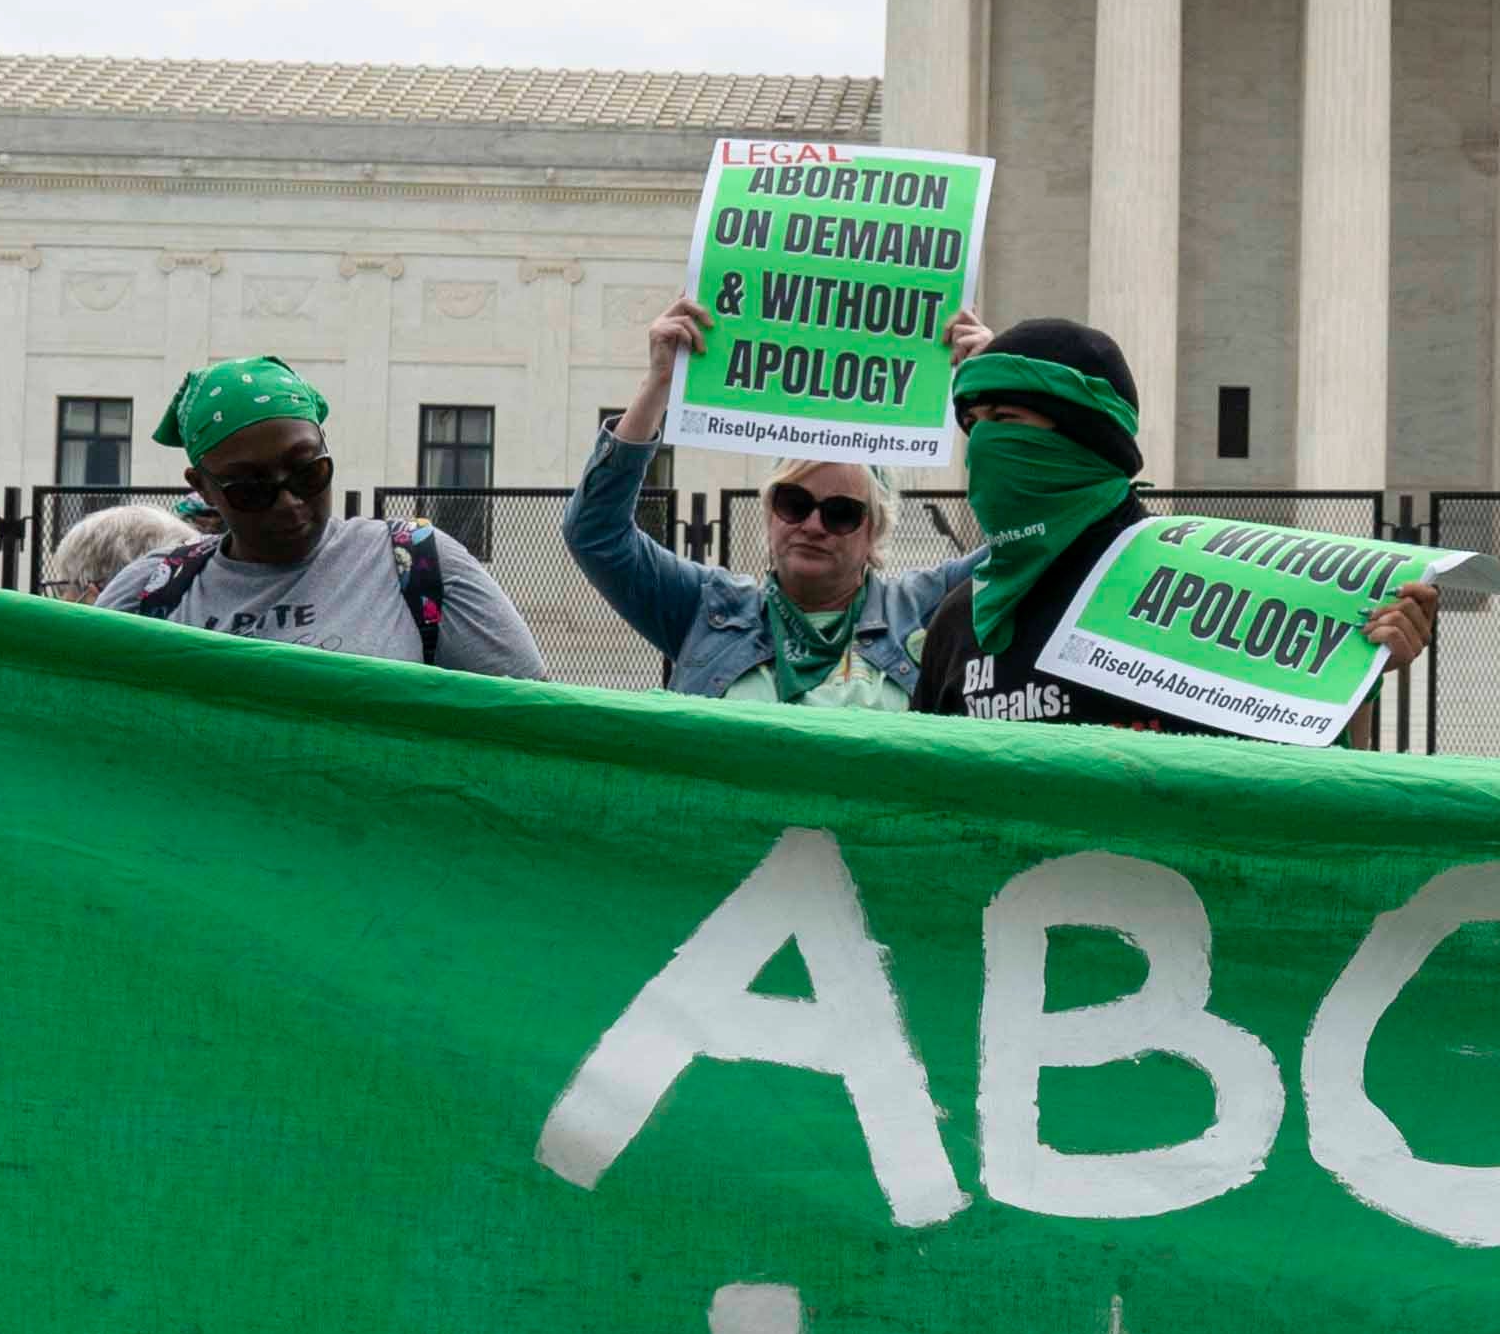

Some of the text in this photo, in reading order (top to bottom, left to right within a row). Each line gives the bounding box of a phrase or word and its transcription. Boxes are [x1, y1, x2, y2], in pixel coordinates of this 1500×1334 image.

[722, 141, 854, 165] LEGAL
[747, 165, 949, 211] ABORTION
[714, 207, 963, 272] ON DEMAND
[715, 270, 945, 341] & WITHOUT
[723, 338, 917, 406] APOLOGY
[707, 415, 940, 456] RiseUp4AbortionRights.org
[1158, 520, 1412, 601] & WITHOUT
[1127, 565, 1355, 677] APOLOGY
[963, 654, 995, 695] BA
[1087, 647, 1333, 735] RiseUp4AbortionRights.org
